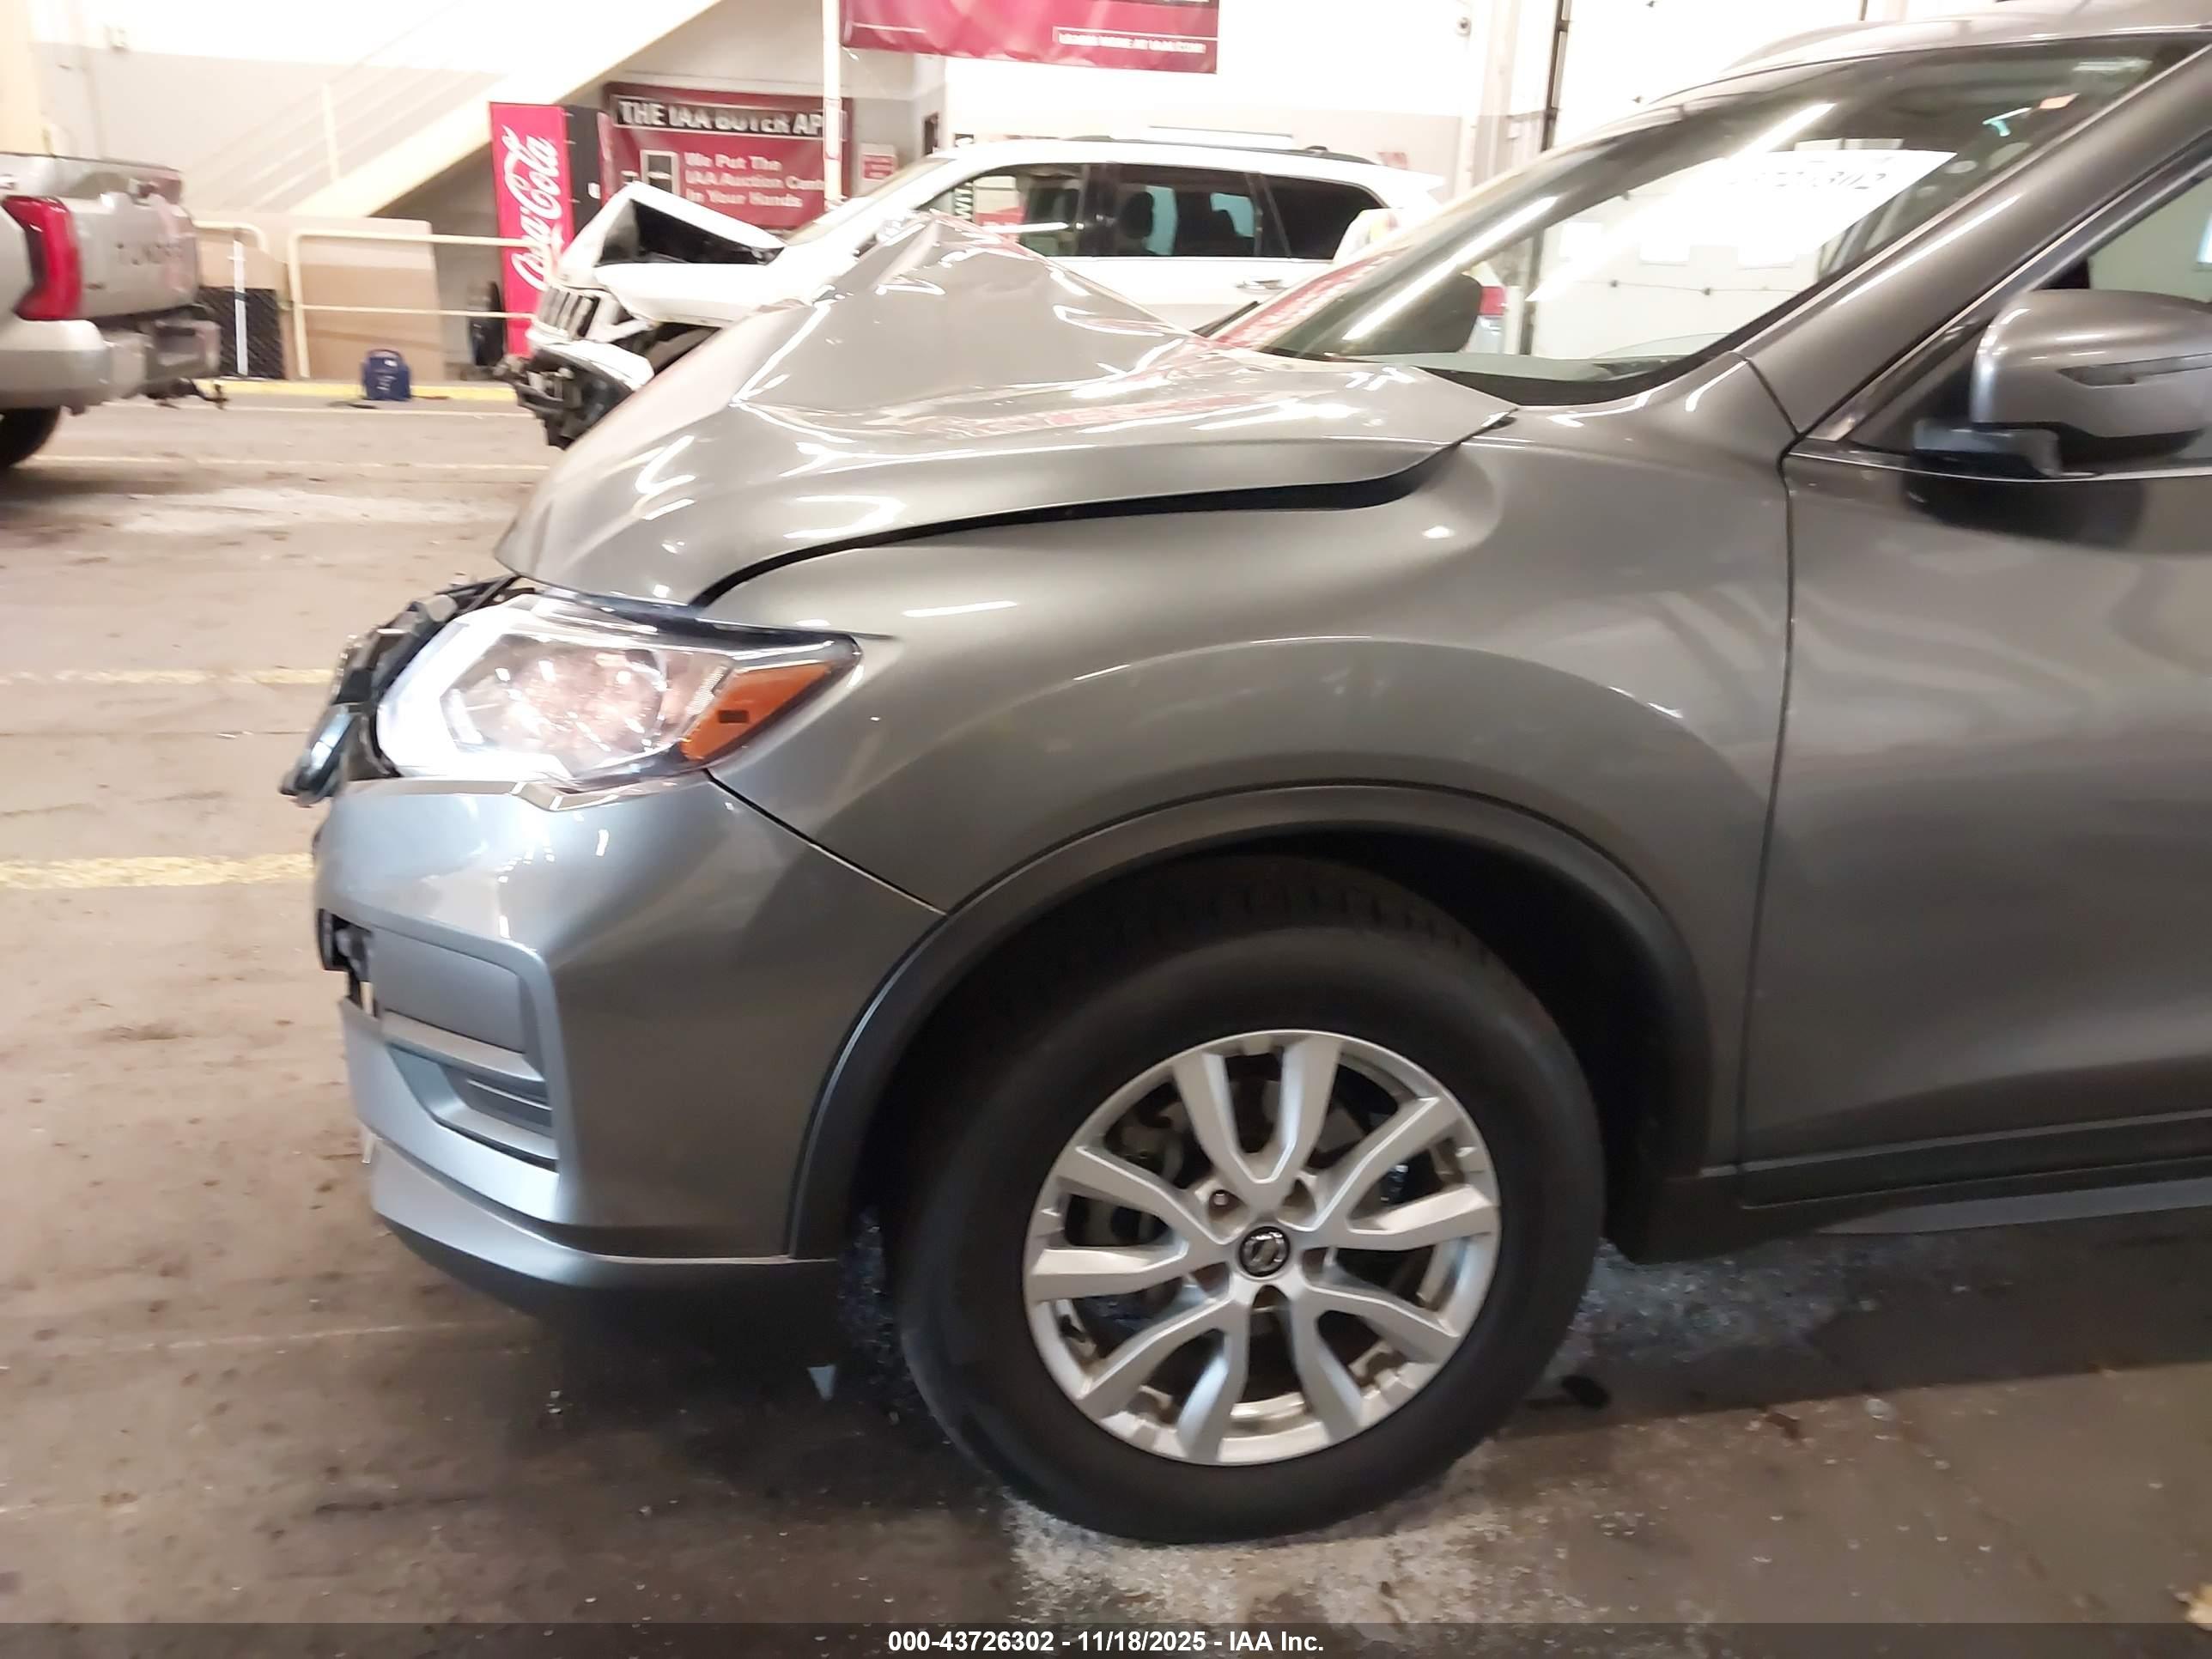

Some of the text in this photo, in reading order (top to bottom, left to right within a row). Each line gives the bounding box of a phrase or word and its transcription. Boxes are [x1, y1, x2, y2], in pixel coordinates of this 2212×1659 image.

[619, 100, 665, 125] THE
[668, 105, 714, 129] IAA
[793, 112, 823, 136] AP
[684, 152, 782, 172] We Put The
[685, 170, 718, 185] IAA
[719, 173, 784, 189] Auction
[706, 190, 746, 205] Your
[748, 191, 804, 208] Hands
